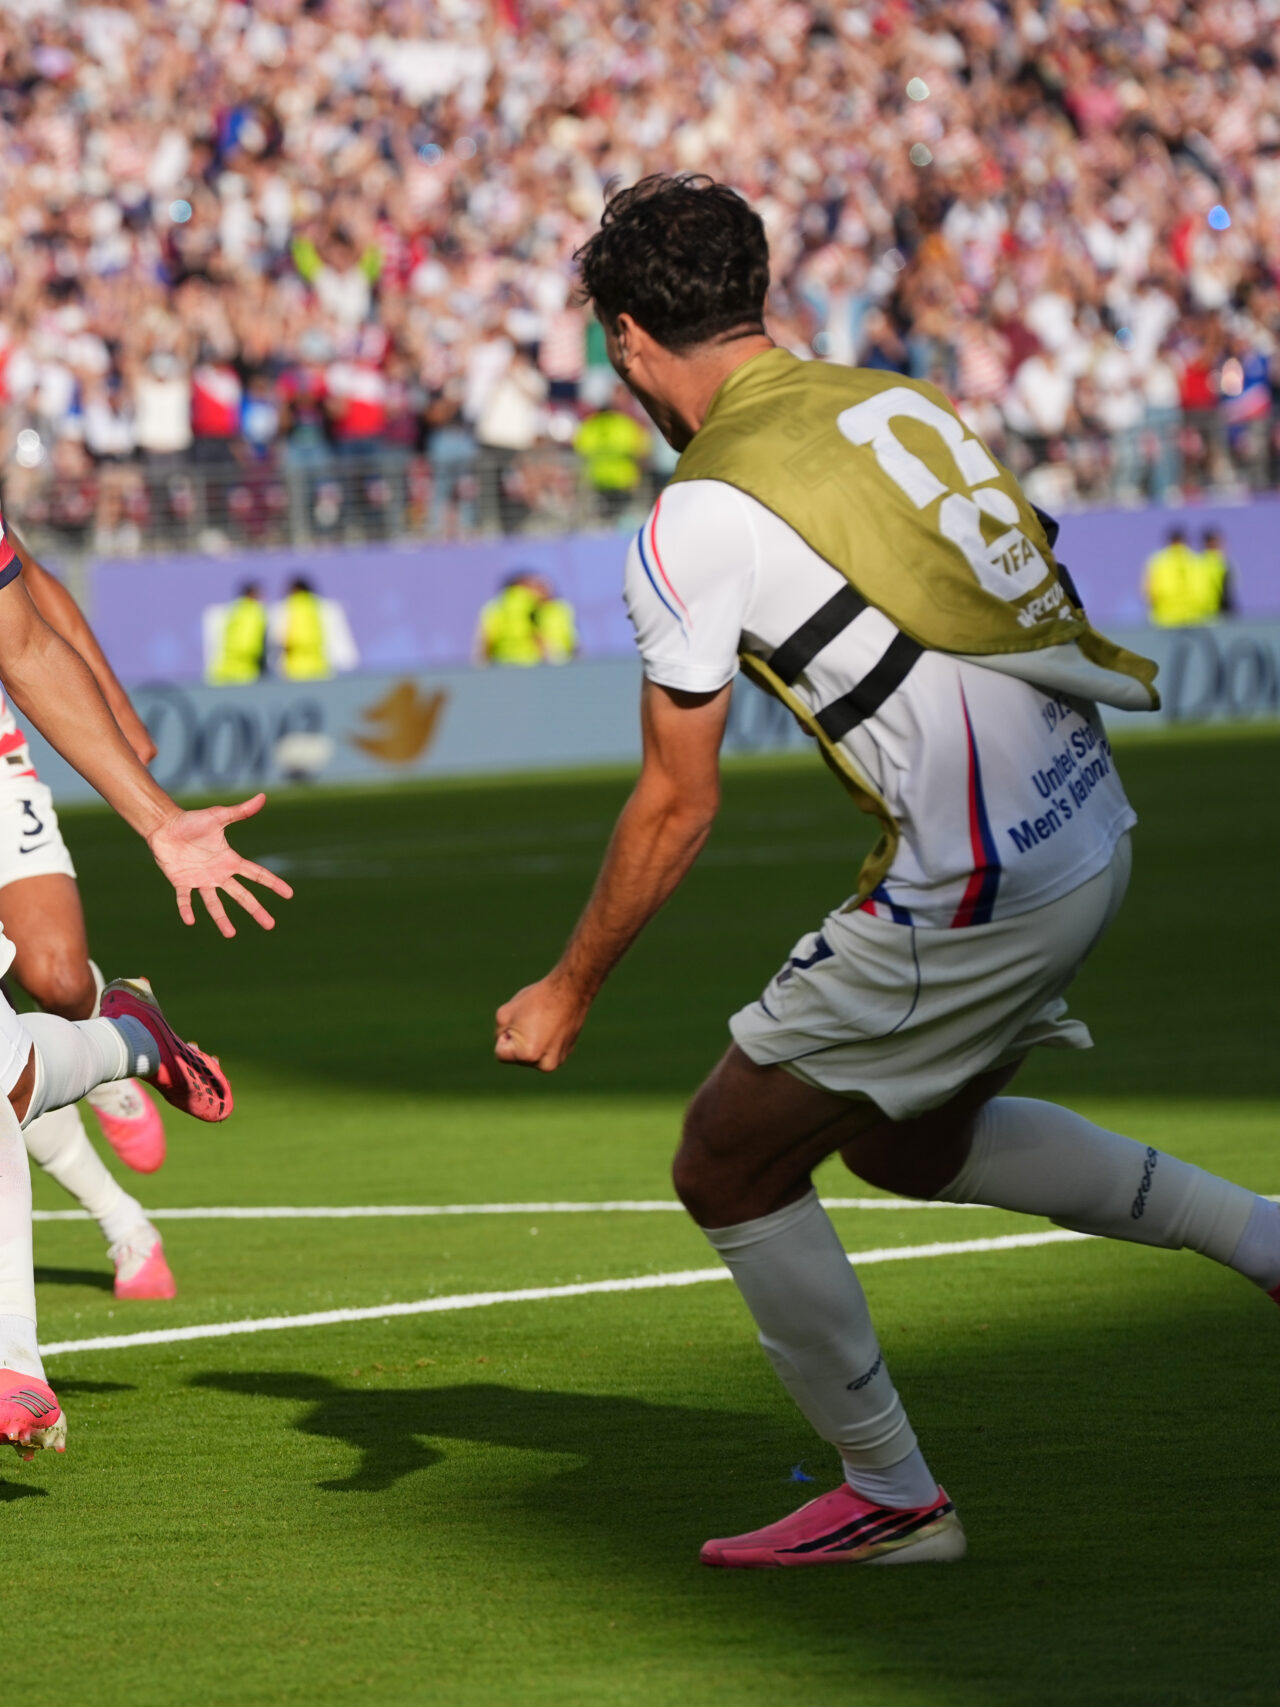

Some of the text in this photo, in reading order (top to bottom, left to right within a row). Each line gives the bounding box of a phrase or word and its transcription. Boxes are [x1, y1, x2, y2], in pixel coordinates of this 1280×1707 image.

[1042, 697, 1072, 734] 191
[22, 799, 44, 836] 3
[1007, 798, 1073, 853] Men's
